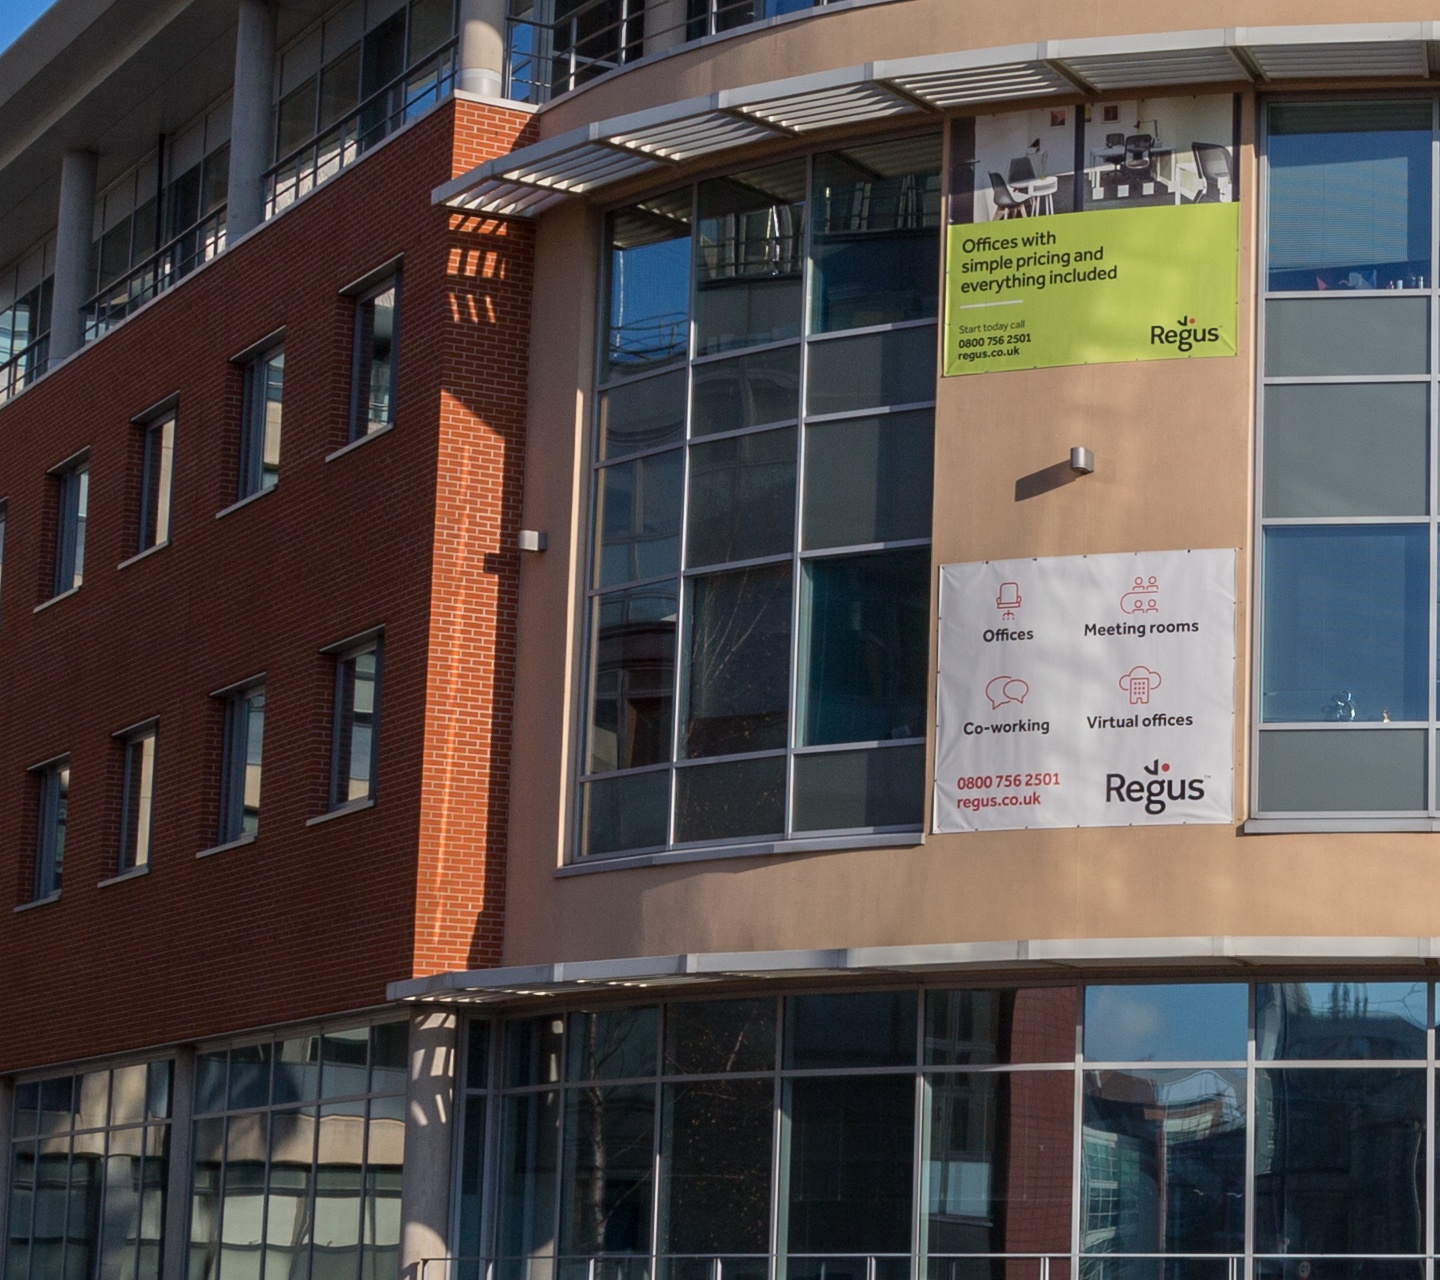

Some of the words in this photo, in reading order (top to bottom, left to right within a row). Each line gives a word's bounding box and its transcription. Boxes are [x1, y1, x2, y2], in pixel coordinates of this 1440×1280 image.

[962, 236, 1018, 254] Offices
[1021, 230, 1056, 248] with
[961, 255, 1013, 275] simple
[1016, 250, 1071, 271] pricing
[1073, 245, 1104, 263] and
[960, 272, 1046, 294] everything
[1049, 265, 1118, 285] included
[959, 324, 981, 335] Start
[983, 322, 1008, 333] today
[1010, 319, 1026, 330] call
[958, 337, 985, 349] 0800
[987, 335, 1005, 347] 756
[1006, 333, 1032, 345] 2501
[1150, 323, 1220, 352] Regus
[957, 346, 1020, 362] regus.co.uk
[982, 628, 1035, 643] Offices
[1083, 622, 1146, 638] Meeting
[1149, 620, 1200, 635] rooms
[963, 720, 1050, 736] Co-working
[1086, 714, 1139, 730] Virtual
[1141, 713, 1194, 728] offices
[957, 776, 993, 791] 0800
[995, 774, 1022, 789] 756
[1024, 773, 1061, 787] 2501
[956, 791, 1042, 812] regus.co.uk
[1105, 772, 1206, 816] Regus
